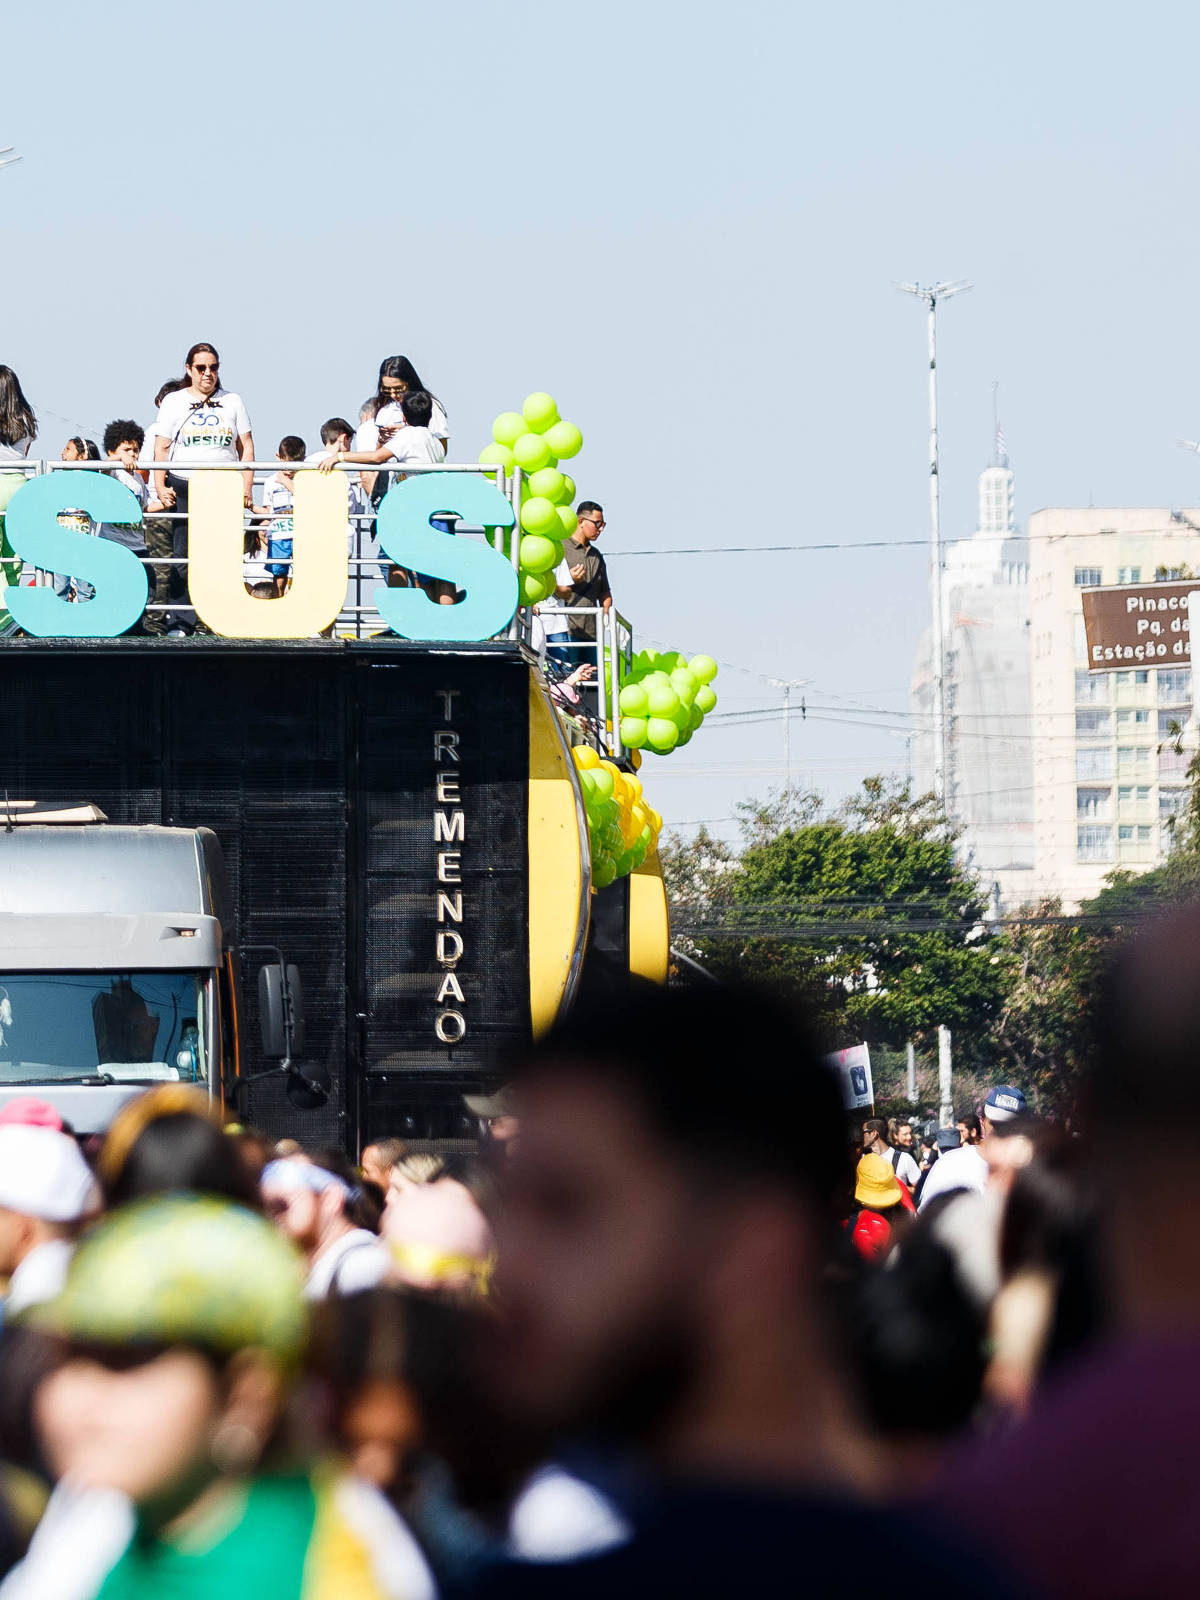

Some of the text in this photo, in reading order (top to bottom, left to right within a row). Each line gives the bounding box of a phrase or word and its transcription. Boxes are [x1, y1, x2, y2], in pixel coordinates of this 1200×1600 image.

[182, 435, 233, 447] JESUS
[1136, 619, 1165, 637] Pq.
[1092, 641, 1167, 662] Estação
